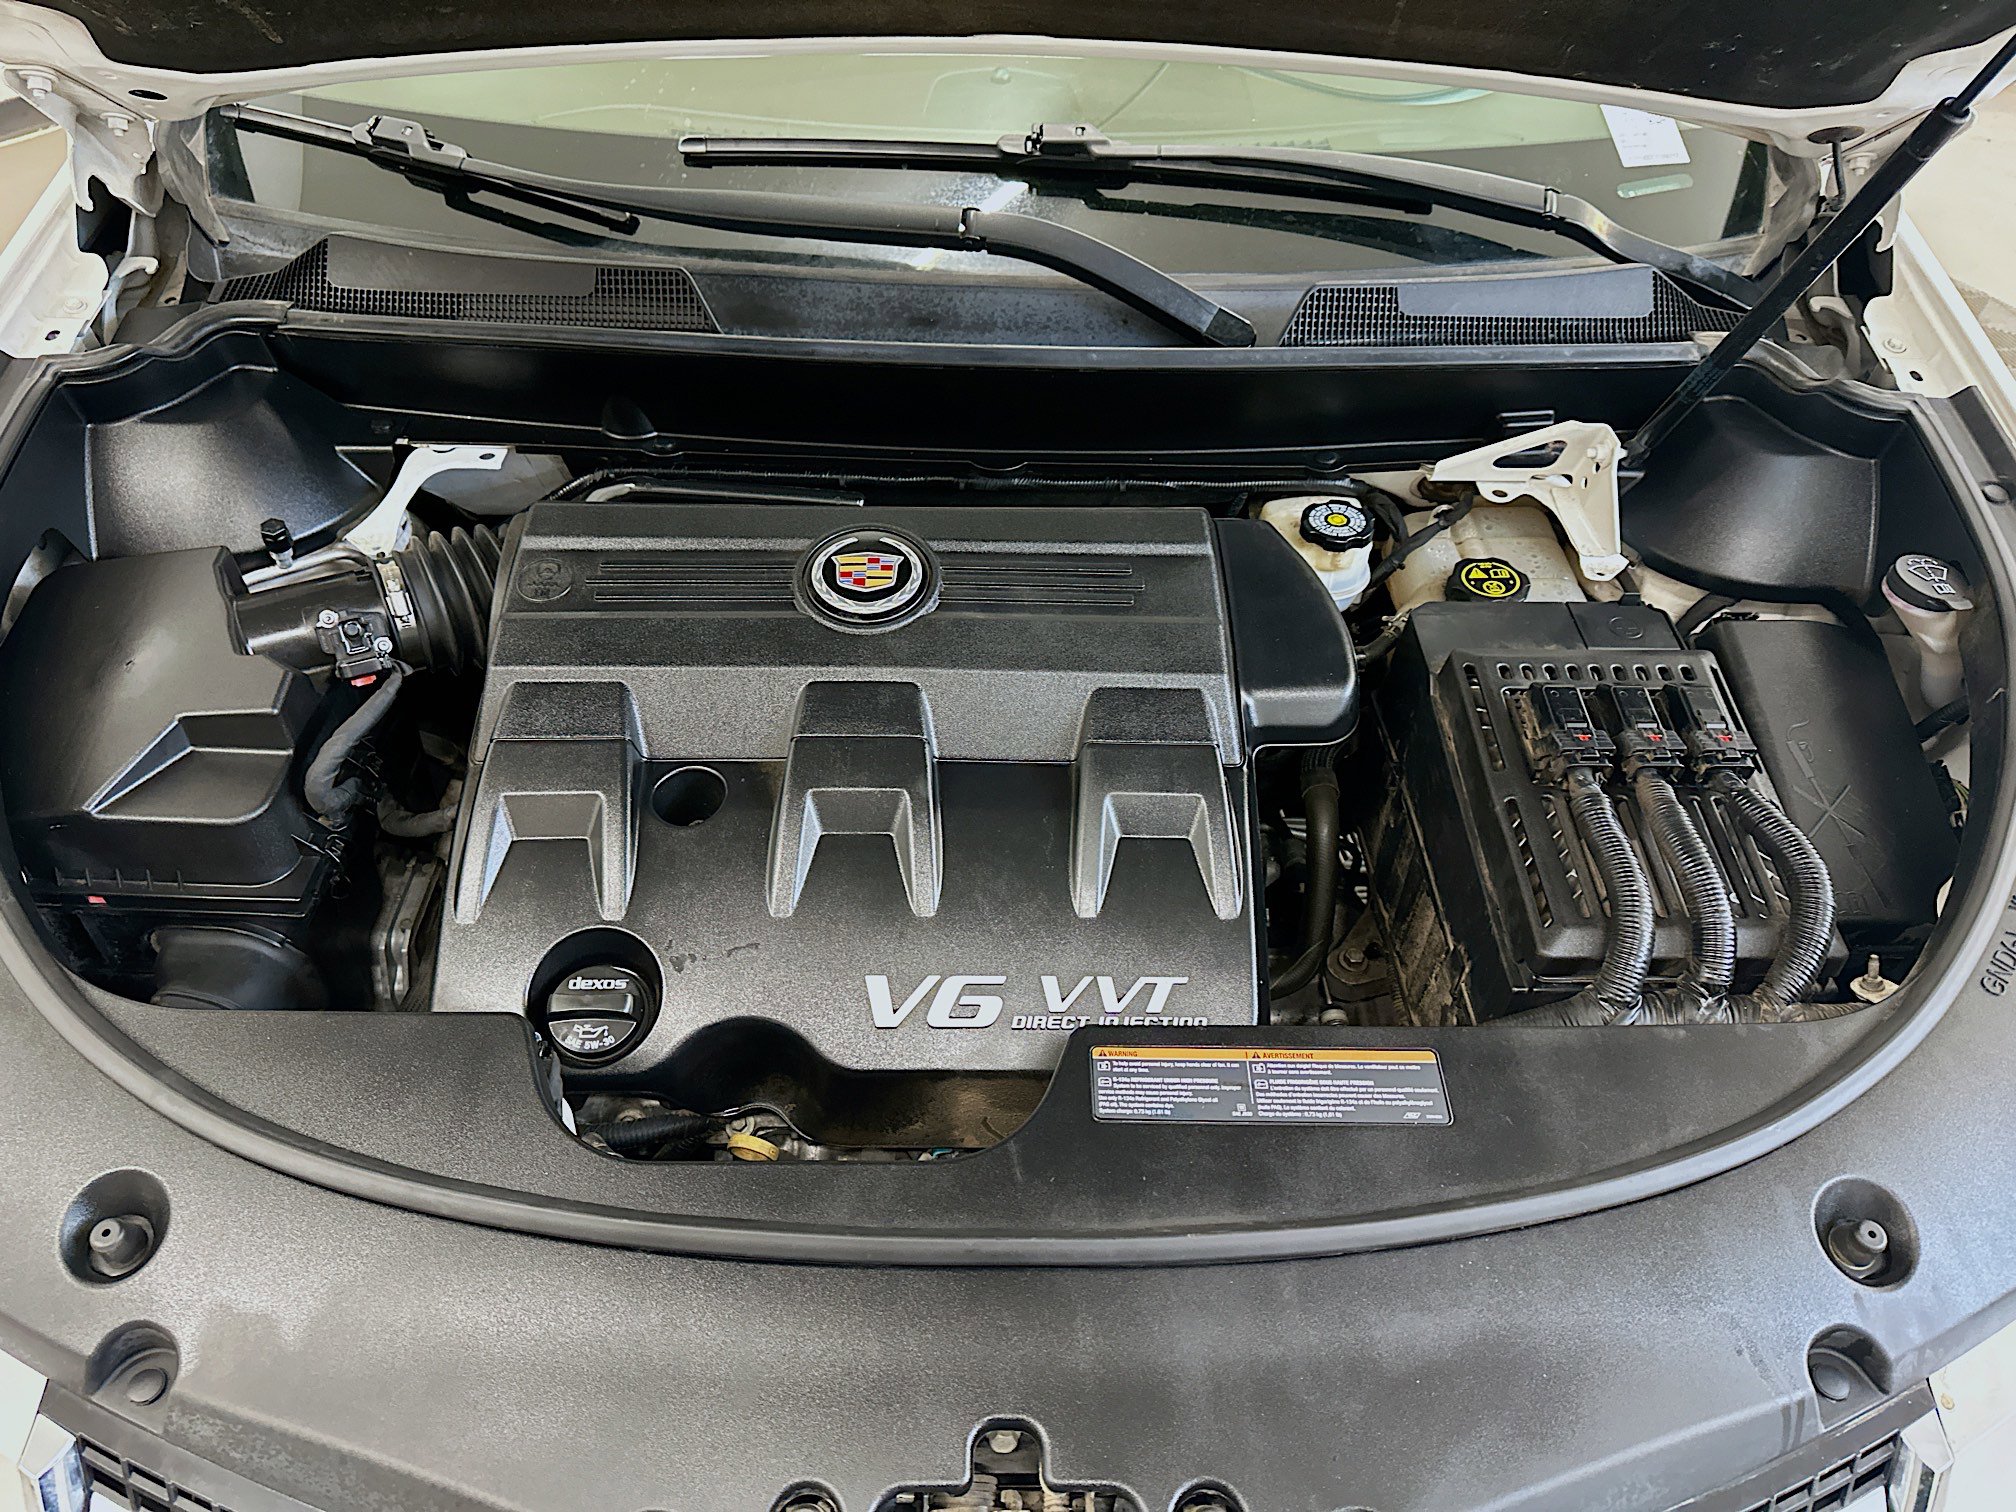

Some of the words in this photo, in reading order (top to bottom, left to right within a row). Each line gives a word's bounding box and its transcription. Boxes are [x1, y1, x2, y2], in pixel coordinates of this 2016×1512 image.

[568, 976, 630, 990] dexos
[865, 975, 1007, 1029] V6
[1040, 975, 1189, 1014] VVT
[1011, 1015, 1090, 1030] DIRECT
[565, 1035, 582, 1049] SAE
[584, 1035, 616, 1050] 5W-30
